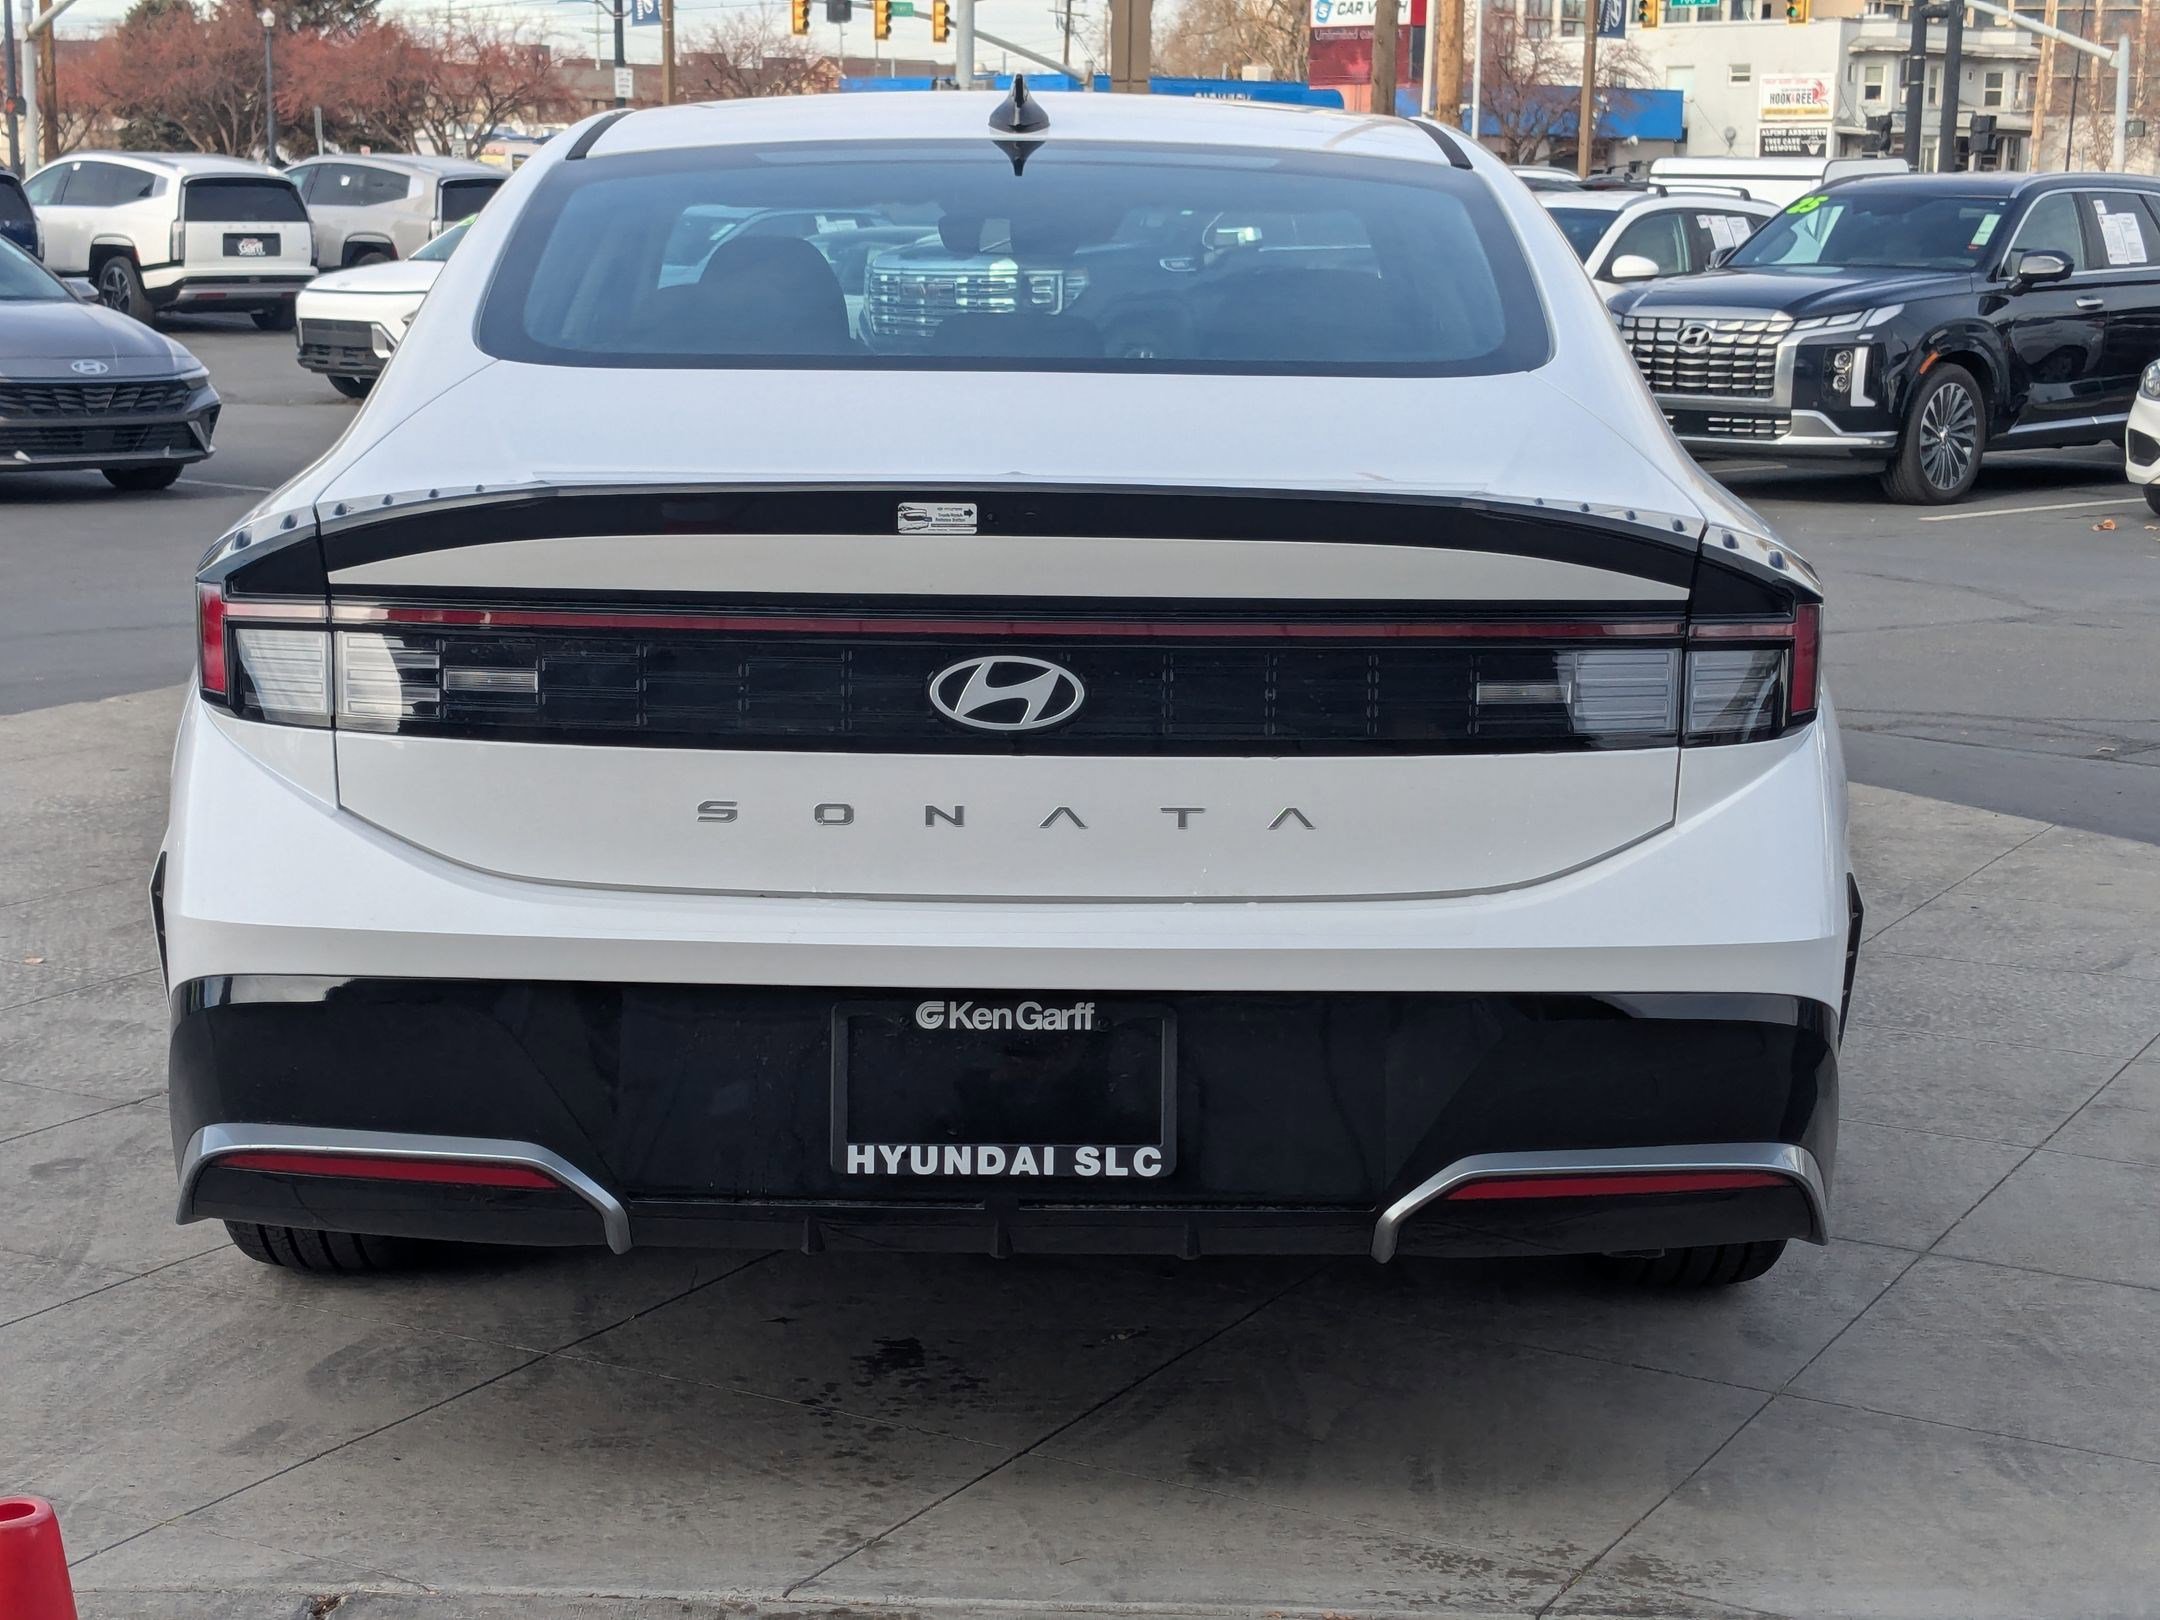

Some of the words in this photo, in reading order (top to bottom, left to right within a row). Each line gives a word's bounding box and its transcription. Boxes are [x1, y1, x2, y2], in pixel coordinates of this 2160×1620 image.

[1337, 1, 1364, 15] CAR
[697, 800, 1316, 830] SONATA
[847, 1145, 1055, 1176] HYUNDAI
[1074, 1146, 1163, 1177] SLC
